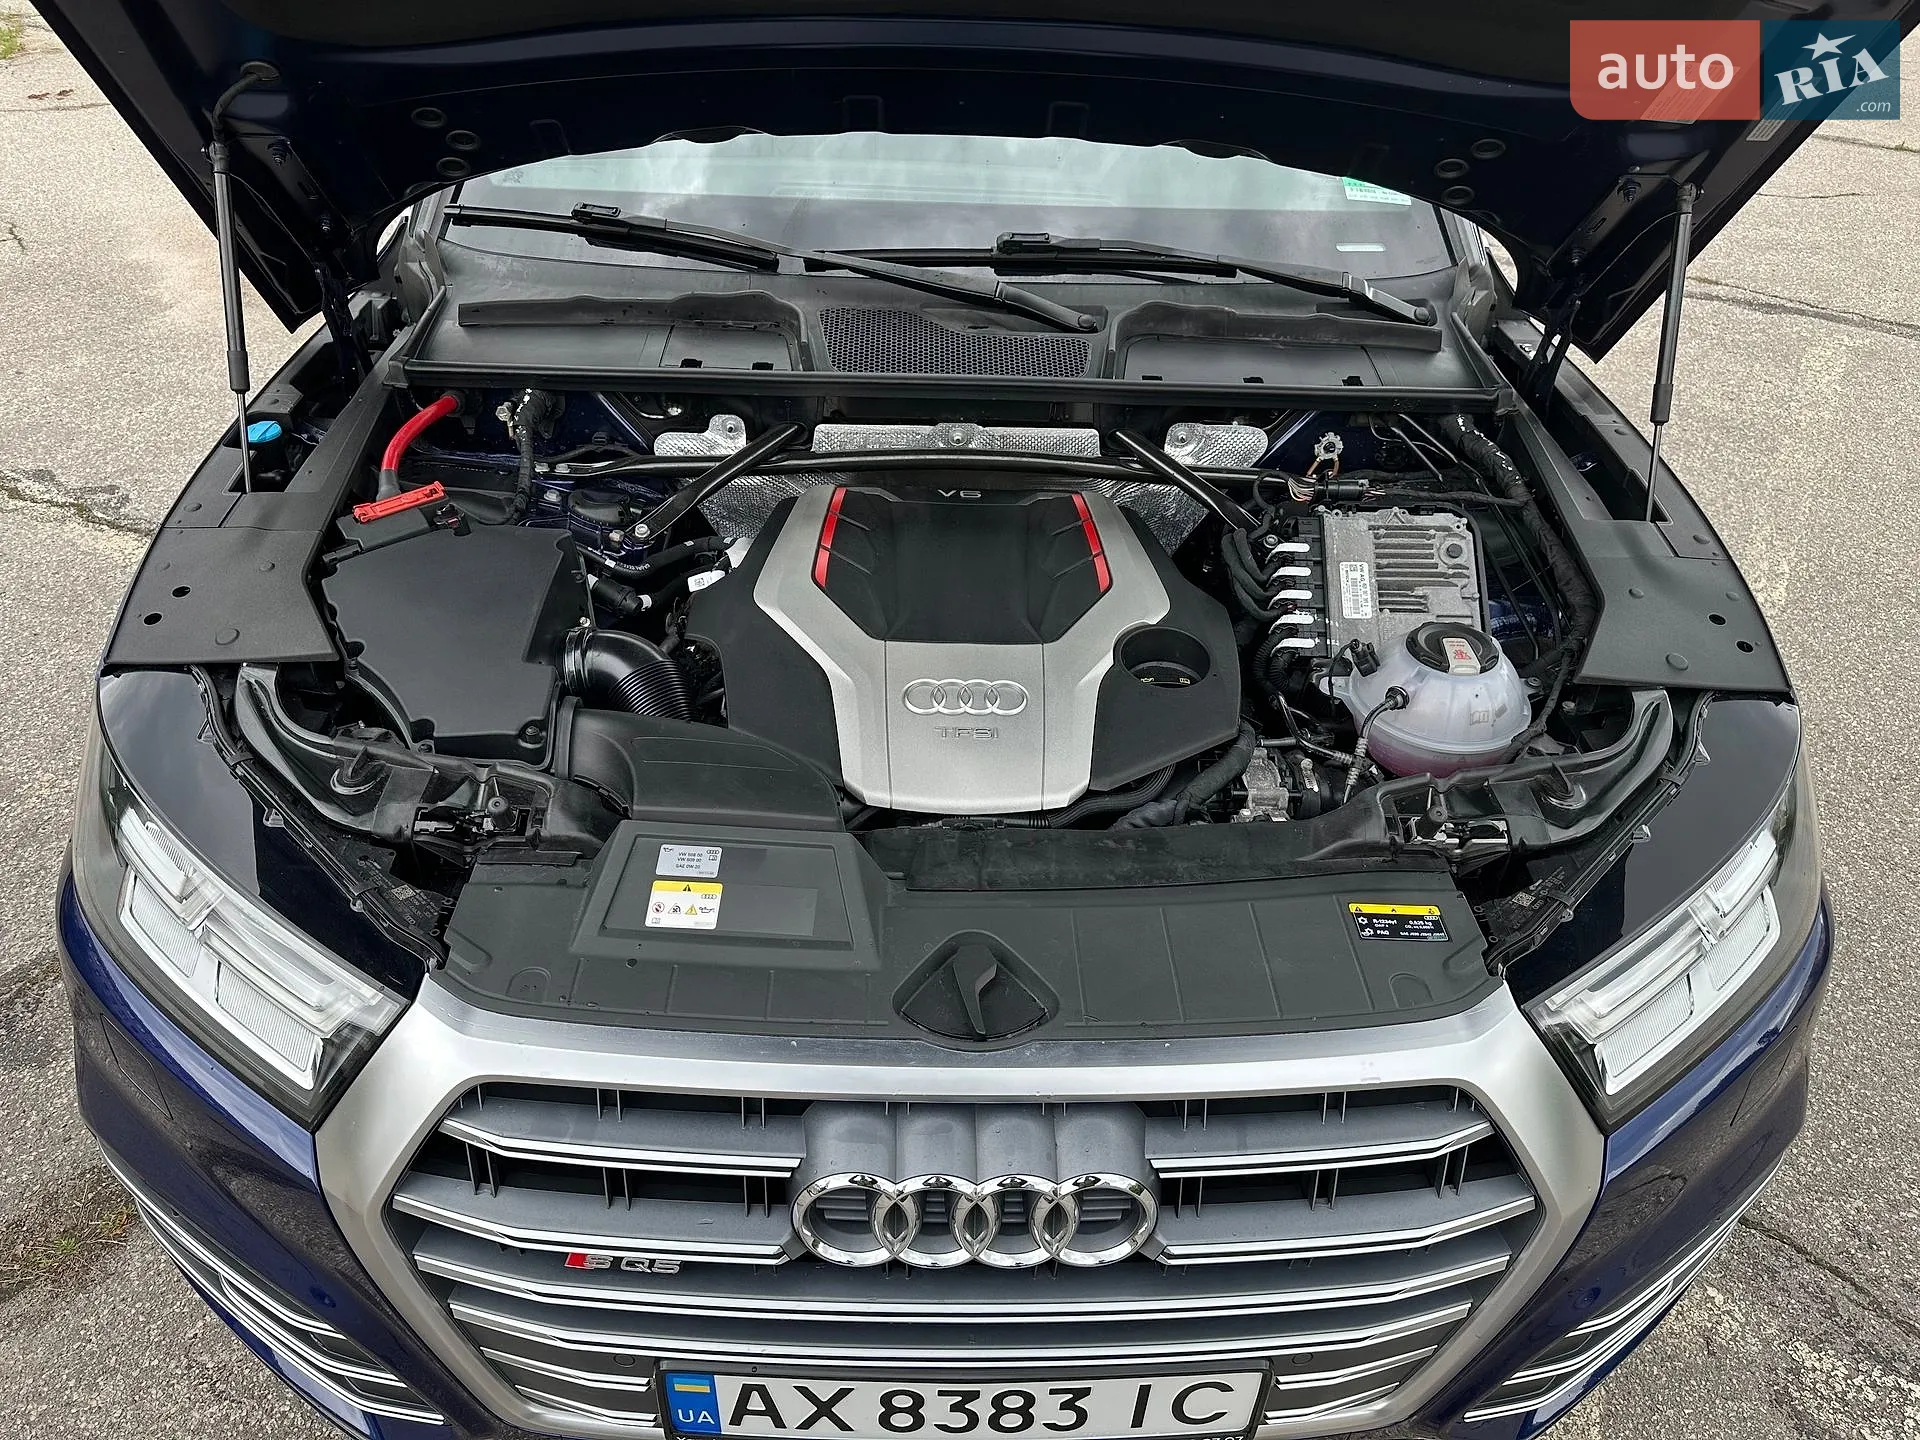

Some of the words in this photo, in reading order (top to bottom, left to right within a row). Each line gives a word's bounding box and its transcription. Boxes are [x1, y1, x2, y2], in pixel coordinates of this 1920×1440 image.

[938, 489, 981, 498] V6
[935, 726, 998, 740] TFSI
[729, 1383, 855, 1431] AX
[878, 1387, 1092, 1433] 8383
[678, 1408, 715, 1424] UA
